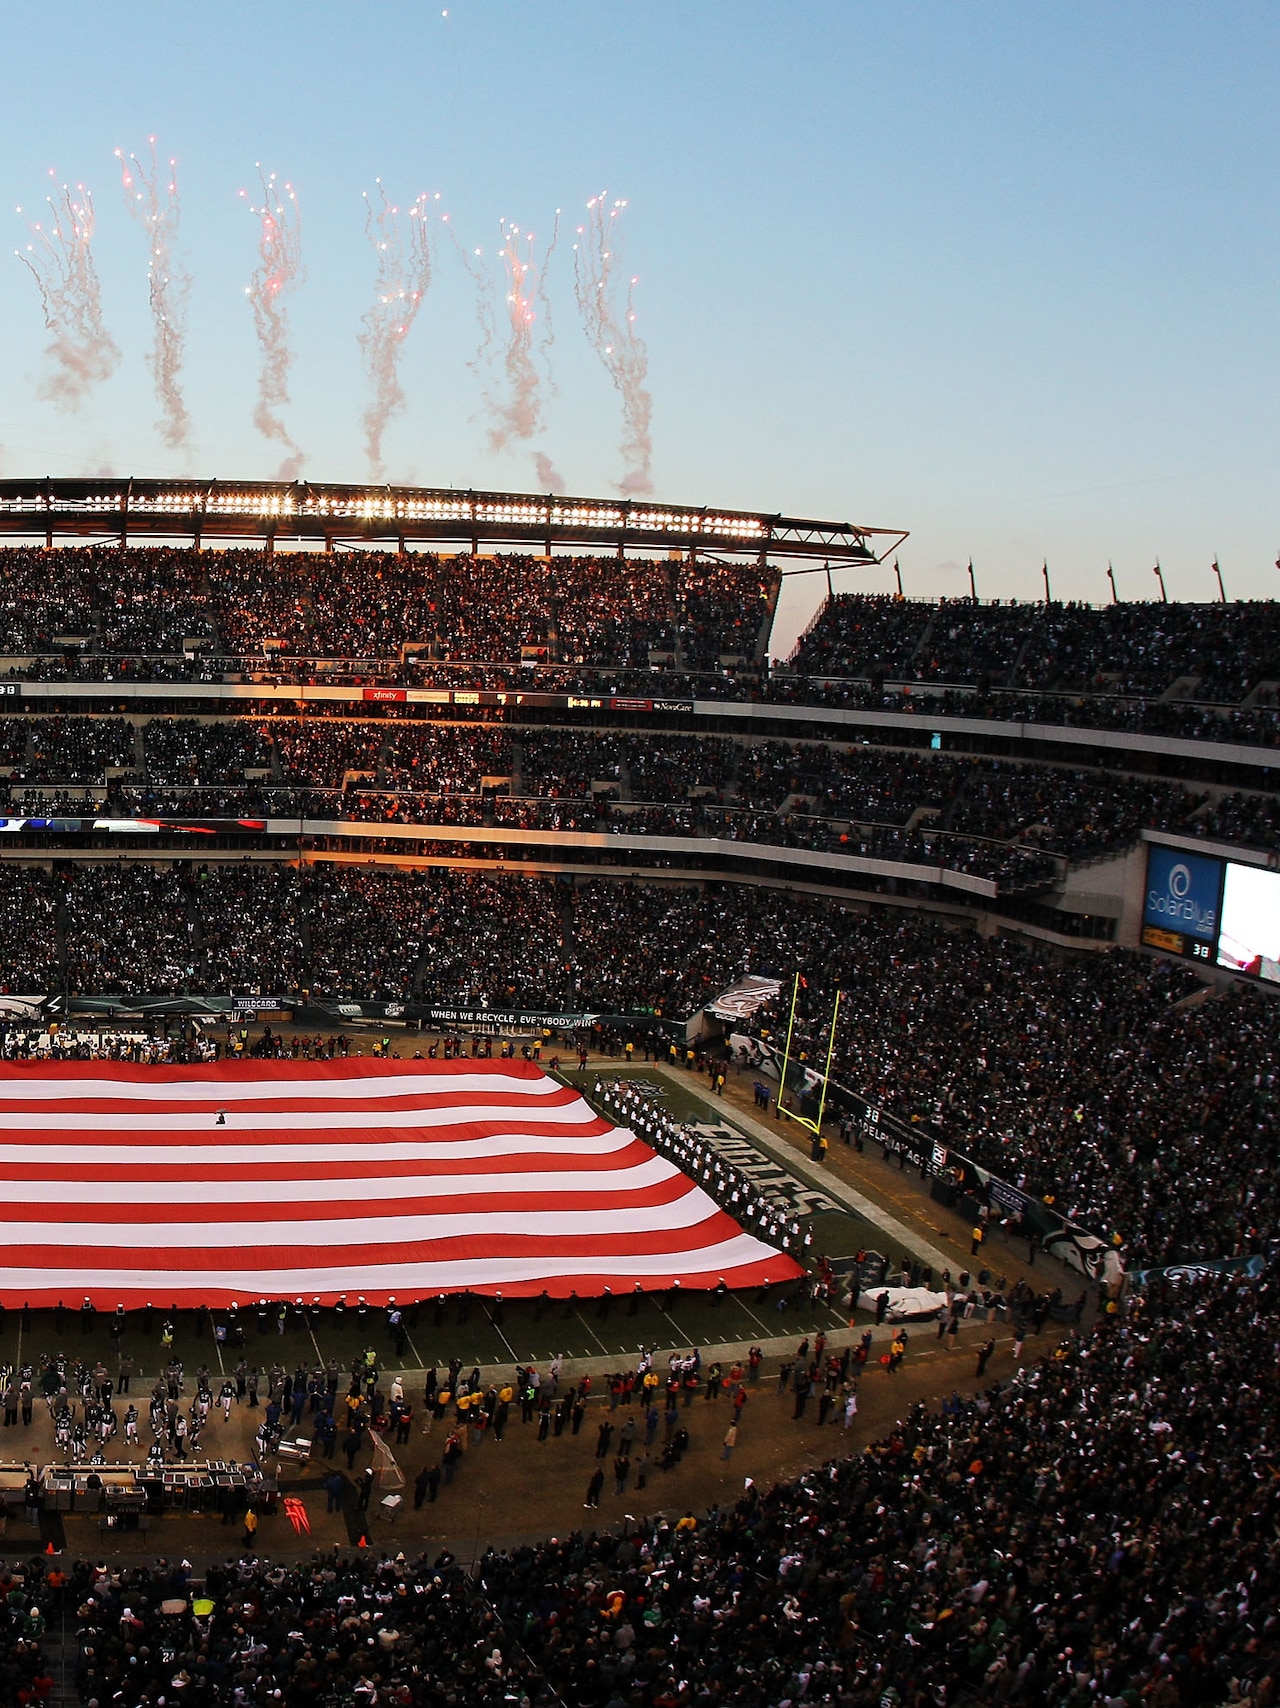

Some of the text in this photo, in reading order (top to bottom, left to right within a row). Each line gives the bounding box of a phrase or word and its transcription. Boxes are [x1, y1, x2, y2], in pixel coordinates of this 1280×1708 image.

[373, 690, 397, 699] xfinity
[660, 702, 693, 712] NovaCare
[1148, 889, 1216, 927] SolarBlue
[237, 1000, 277, 1009] WILDCARD
[430, 1010, 457, 1020] WHEN
[459, 1011, 474, 1020] WE
[476, 1013, 518, 1024] RECYCLE,
